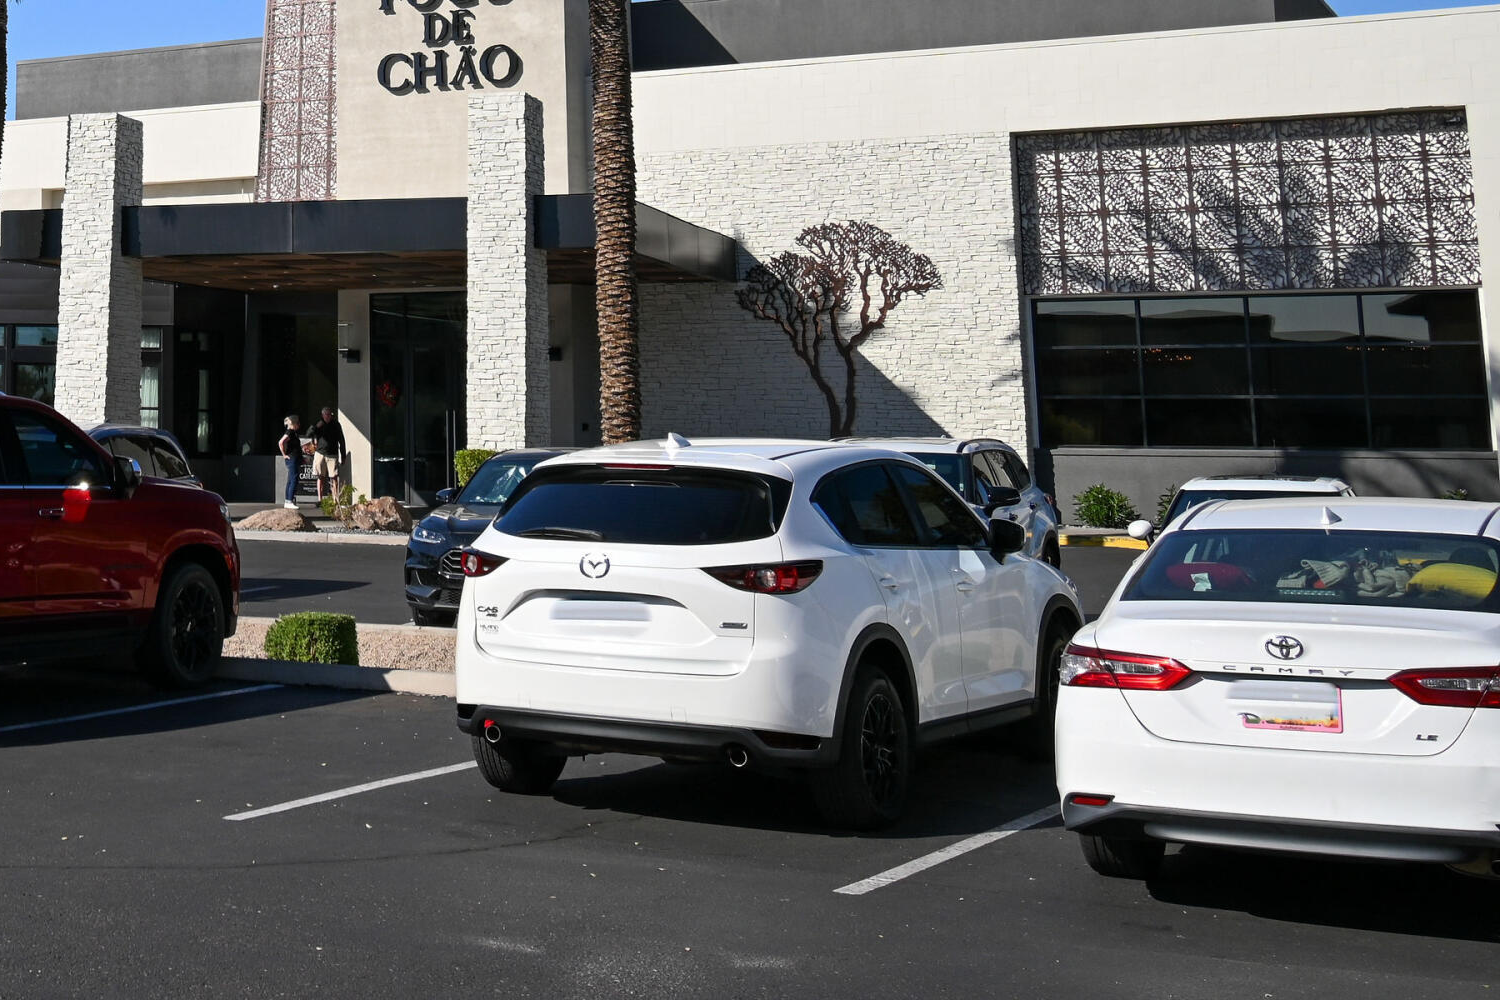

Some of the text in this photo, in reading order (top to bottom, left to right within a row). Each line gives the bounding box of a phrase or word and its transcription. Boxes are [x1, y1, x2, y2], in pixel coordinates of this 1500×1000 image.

[421, 9, 476, 48] DE
[377, 44, 524, 97] CHÃO
[1222, 665, 1354, 676] CAMRY
[1416, 734, 1439, 742] LE
